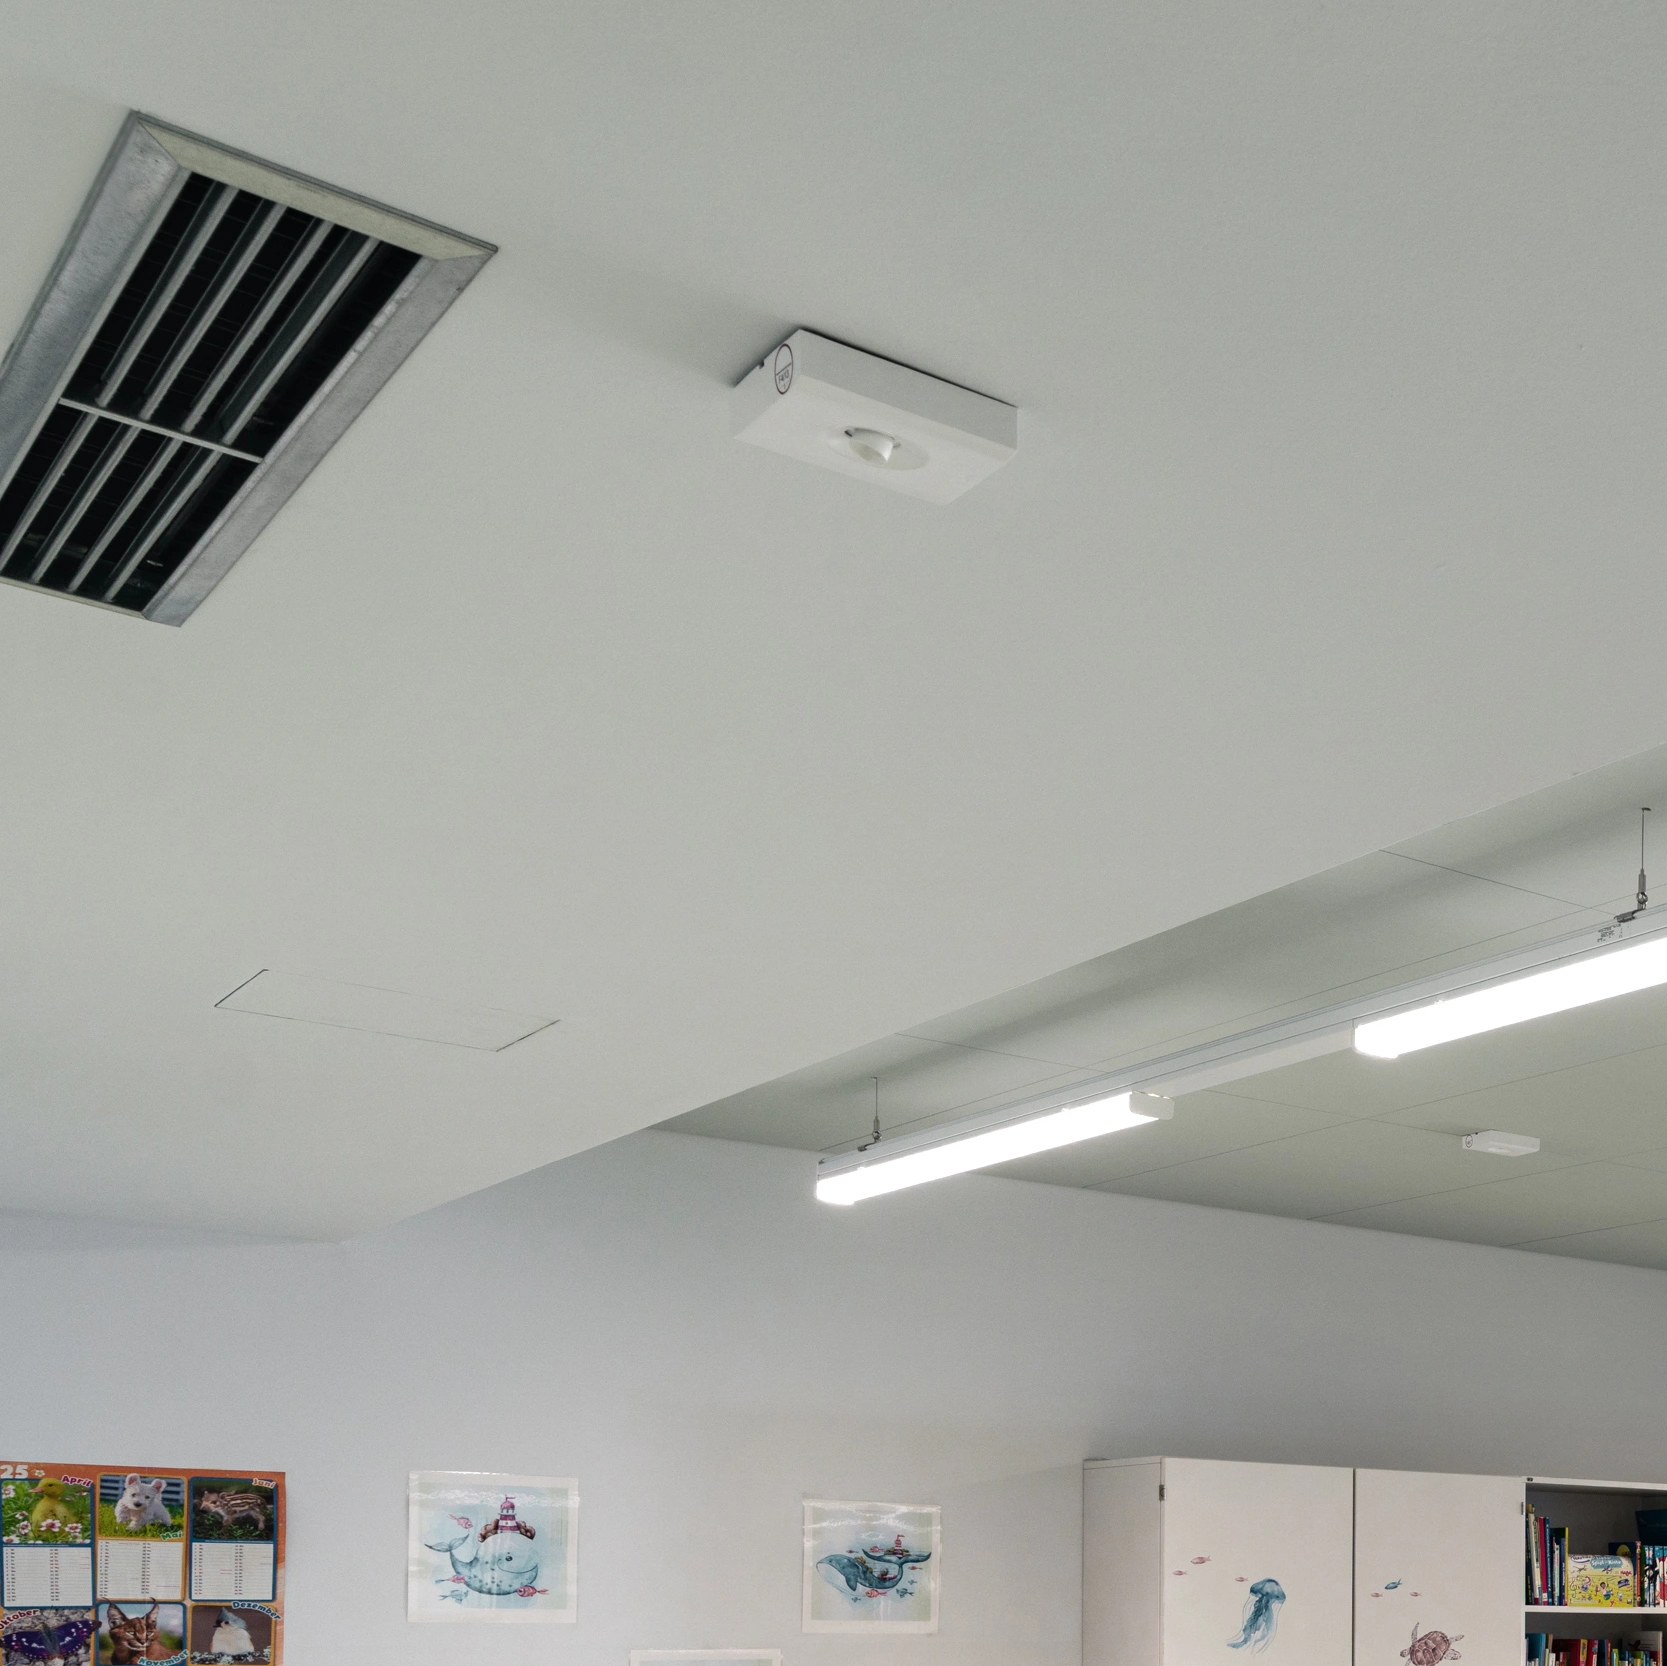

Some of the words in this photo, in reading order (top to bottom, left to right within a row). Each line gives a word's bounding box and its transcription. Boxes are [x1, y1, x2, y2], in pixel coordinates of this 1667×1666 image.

[61, 1474, 94, 1487] April
[252, 1477, 276, 1489] Juni
[161, 1531, 183, 1540] Mai
[231, 1600, 281, 1620] Dezember
